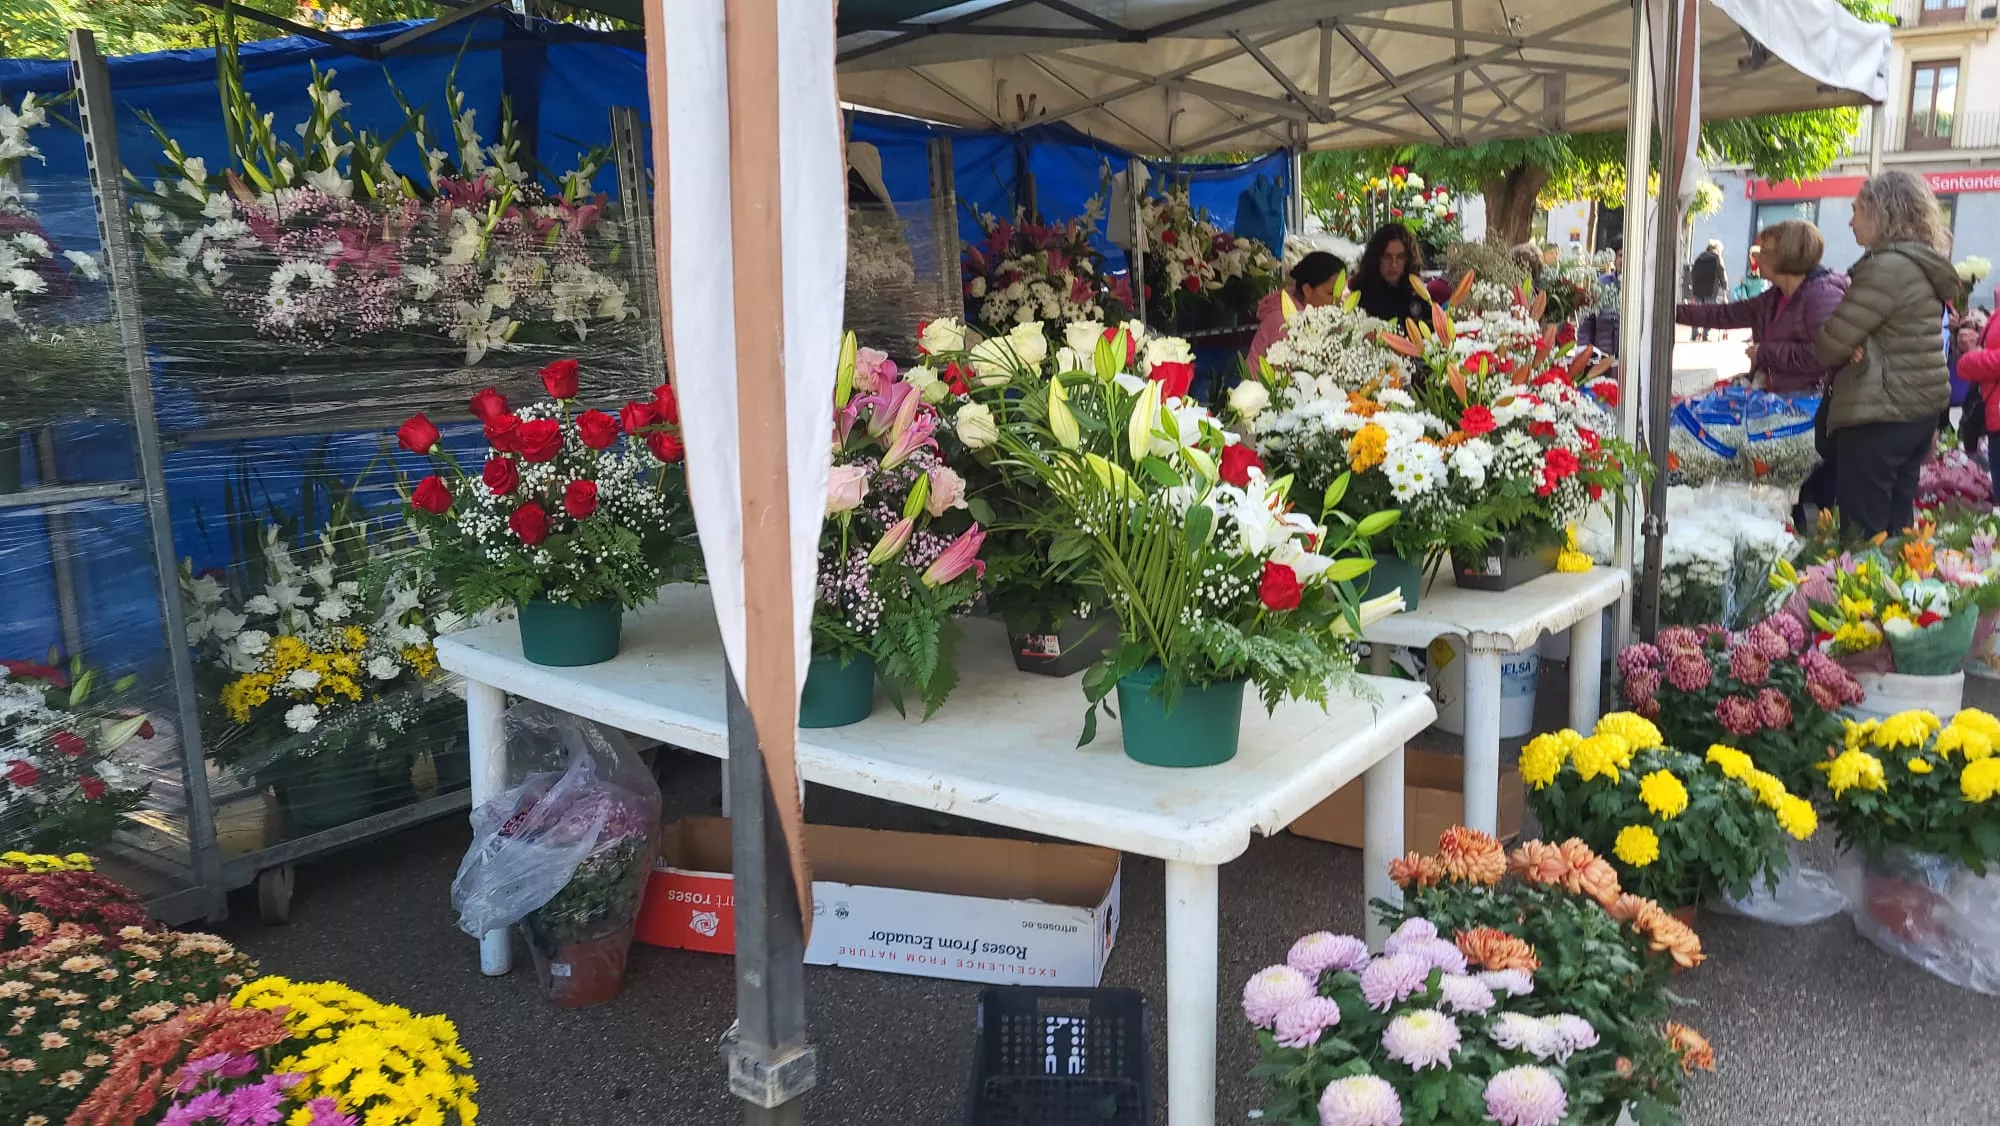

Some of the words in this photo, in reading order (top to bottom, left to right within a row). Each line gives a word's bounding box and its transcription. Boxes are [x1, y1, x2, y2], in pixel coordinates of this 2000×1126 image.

[668, 890, 710, 904] roses
[1022, 920, 1078, 933] artroses.ec
[868, 930, 933, 950] Ecuador
[939, 937, 979, 955] from
[839, 946, 896, 960] NATURE
[906, 952, 946, 966] FROM
[982, 942, 1028, 960] Roses
[957, 959, 1056, 977] EXCELLENCE
